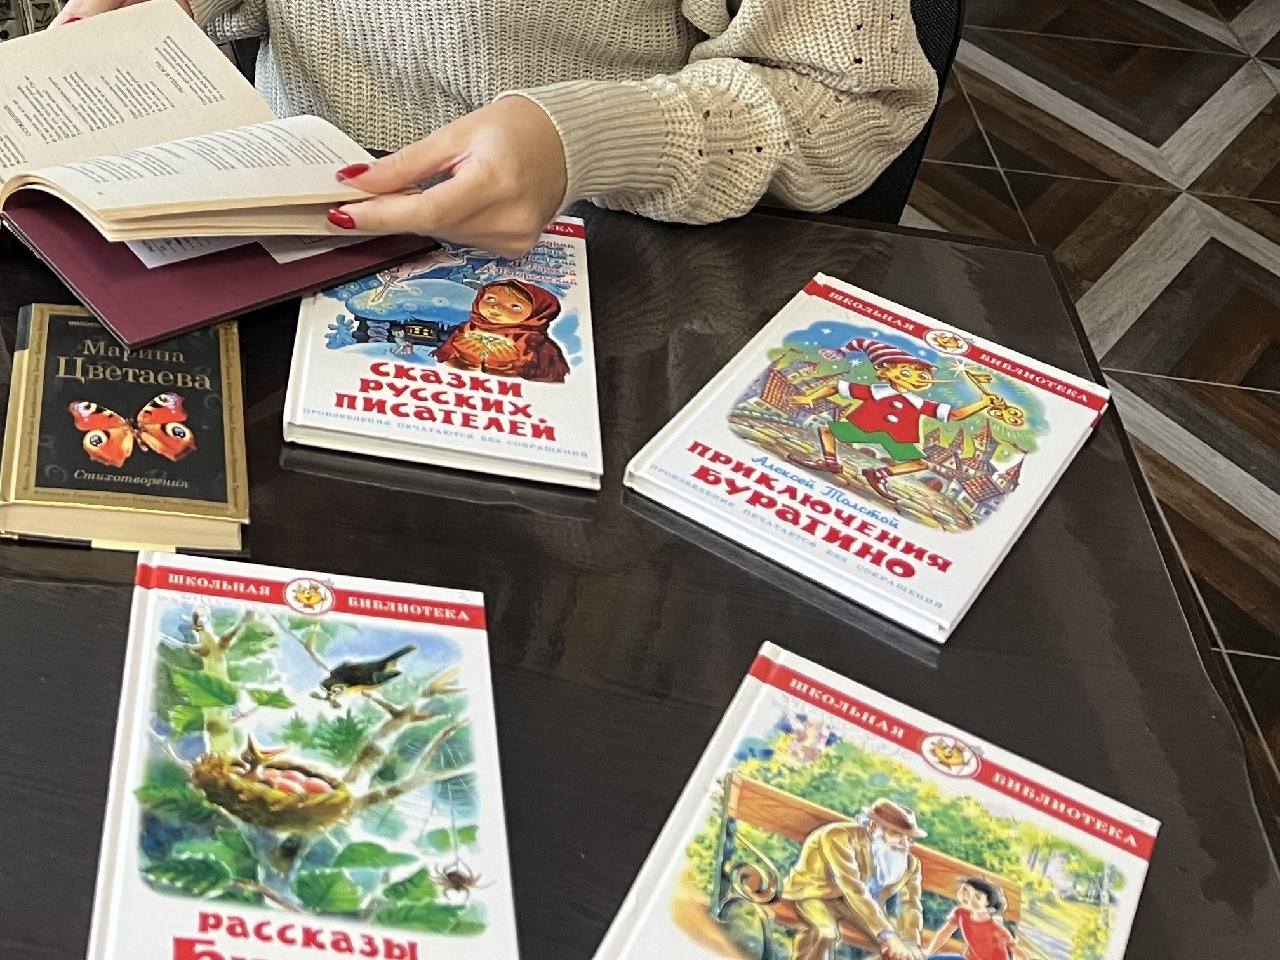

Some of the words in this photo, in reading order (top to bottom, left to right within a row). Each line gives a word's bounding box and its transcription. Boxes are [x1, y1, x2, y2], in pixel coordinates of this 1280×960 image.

[55, 356, 212, 391] Цветаева
[83, 339, 186, 364] Марина
[828, 289, 915, 333] ШКОЛЬНАЯ
[979, 351, 1089, 404] БИБЛИОТЕКА
[480, 434, 501, 444] БЕЗ
[73, 469, 190, 489] Стихотворения
[686, 440, 954, 574] ПРИКЛЮЧЕНИЯ
[751, 456, 815, 490] Алексей
[822, 485, 900, 530] Толстой
[690, 464, 917, 579] БУРАТИНО
[167, 572, 271, 597] ШКОЛЬНАЯ
[347, 595, 471, 622] БИБЛИОТЕКА
[789, 677, 905, 740] ШКОЛЬНАЯ
[992, 770, 1139, 849] БИБЛИОТЕКА
